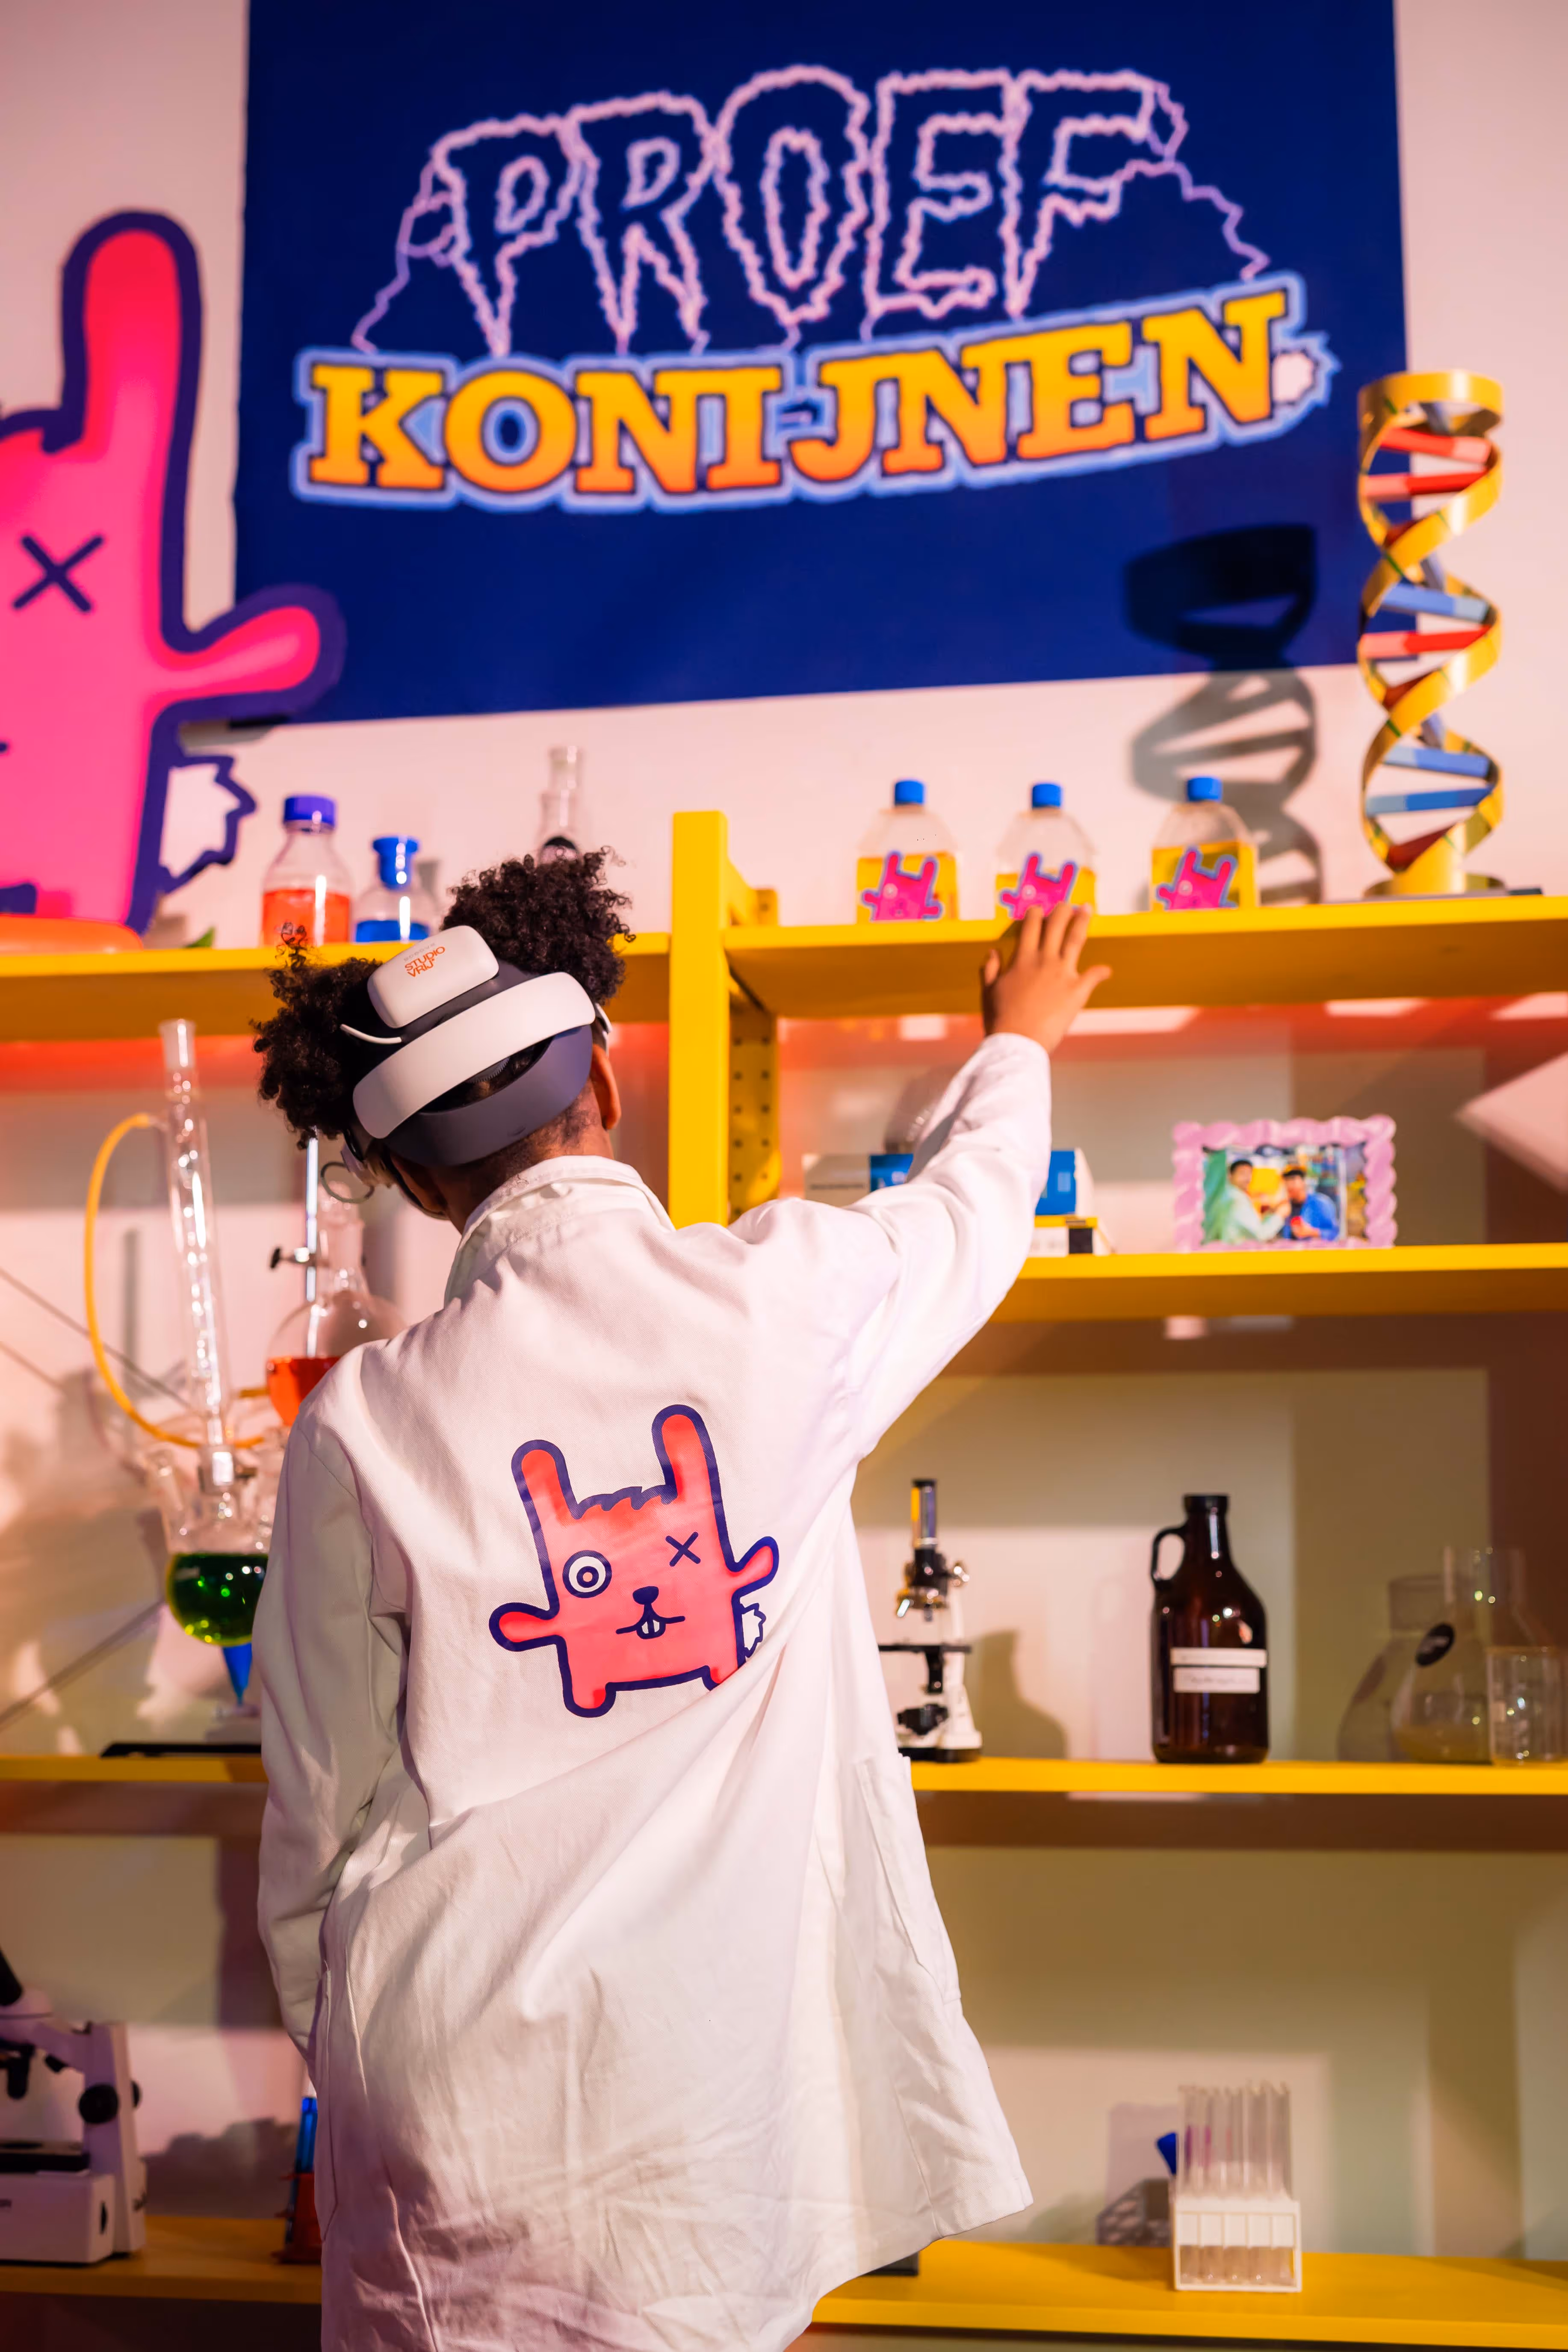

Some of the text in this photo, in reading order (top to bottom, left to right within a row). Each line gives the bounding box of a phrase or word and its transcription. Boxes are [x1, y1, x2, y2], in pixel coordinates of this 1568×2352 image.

[430, 64, 1169, 356] PROEF
[306, 288, 1288, 495] KONIJNEN
[405, 946, 445, 971] STUDIO
